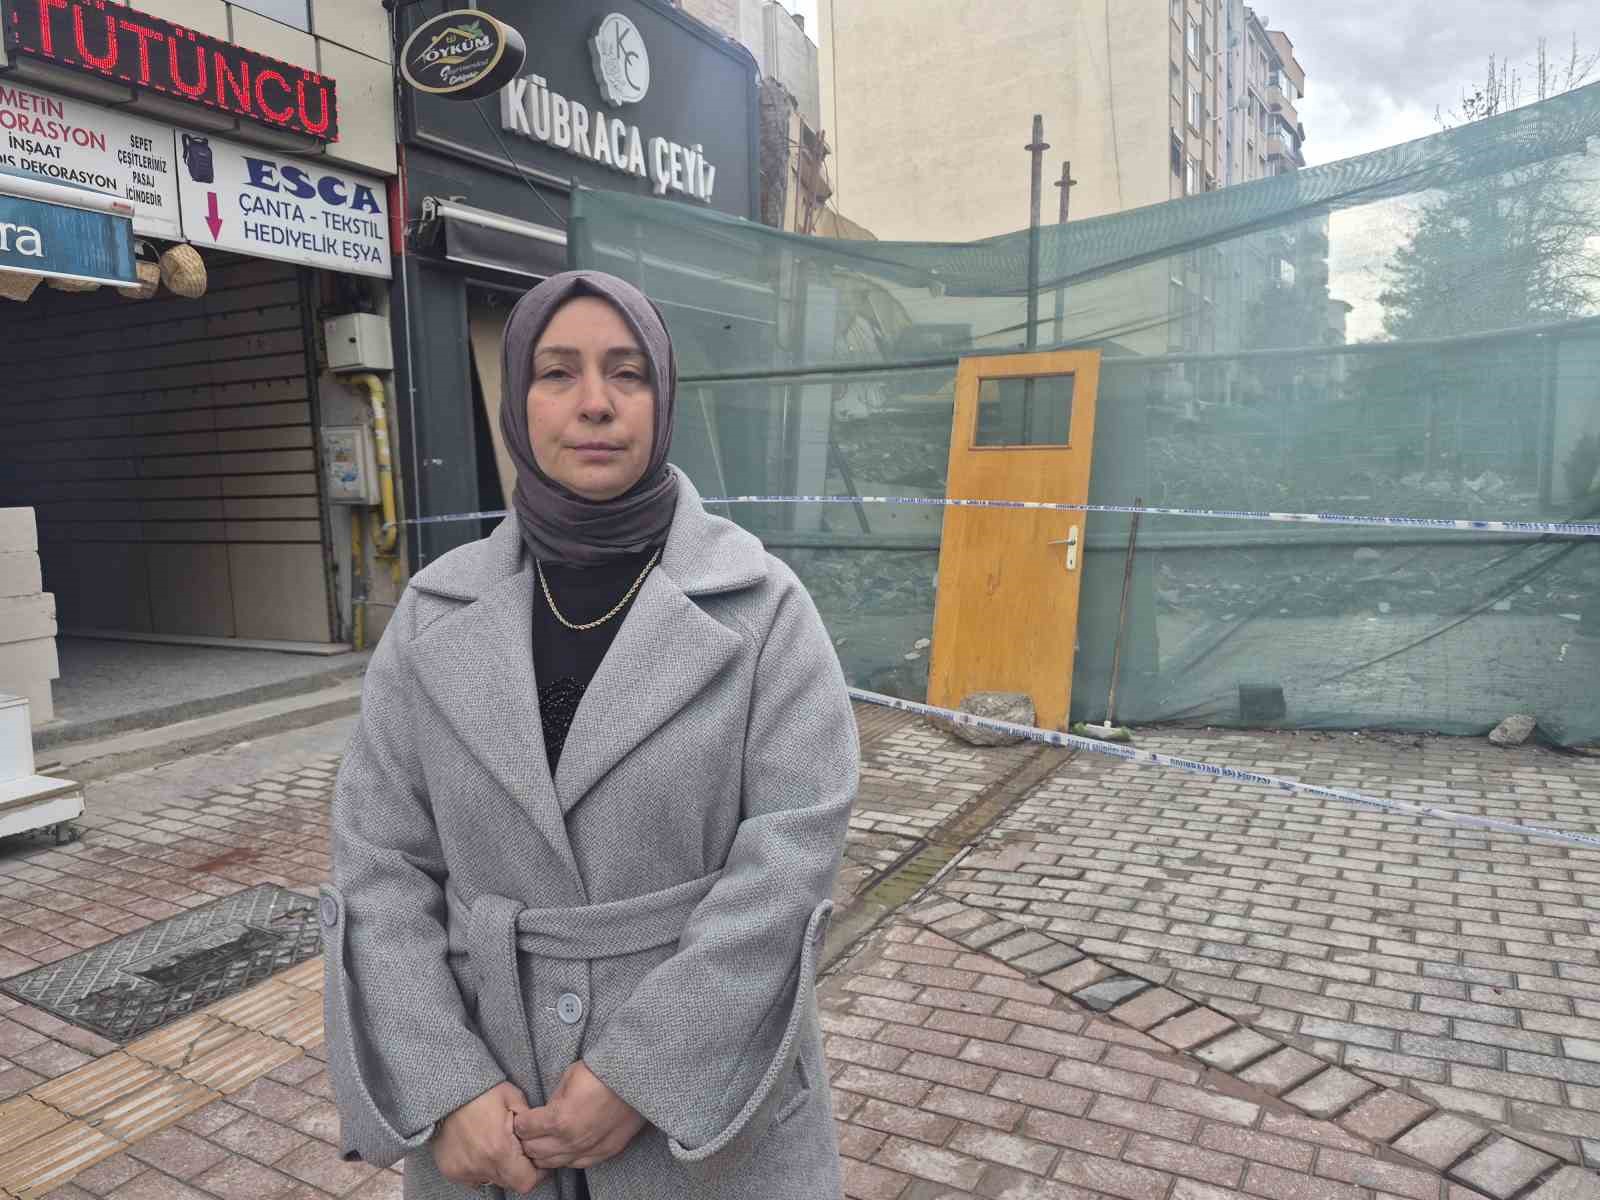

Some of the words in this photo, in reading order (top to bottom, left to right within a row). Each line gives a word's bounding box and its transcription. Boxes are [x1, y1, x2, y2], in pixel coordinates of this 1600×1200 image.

[501, 75, 647, 177] KÜBRACA
[8, 131, 62, 159] İNŞAAT
[130, 134, 153, 153] SEPET
[20, 158, 118, 192] DEKORASYON
[132, 171, 155, 188] PASAJ
[240, 156, 383, 214] ESCA
[238, 193, 306, 223] ÇANTA
[342, 240, 383, 264] EŞYA
